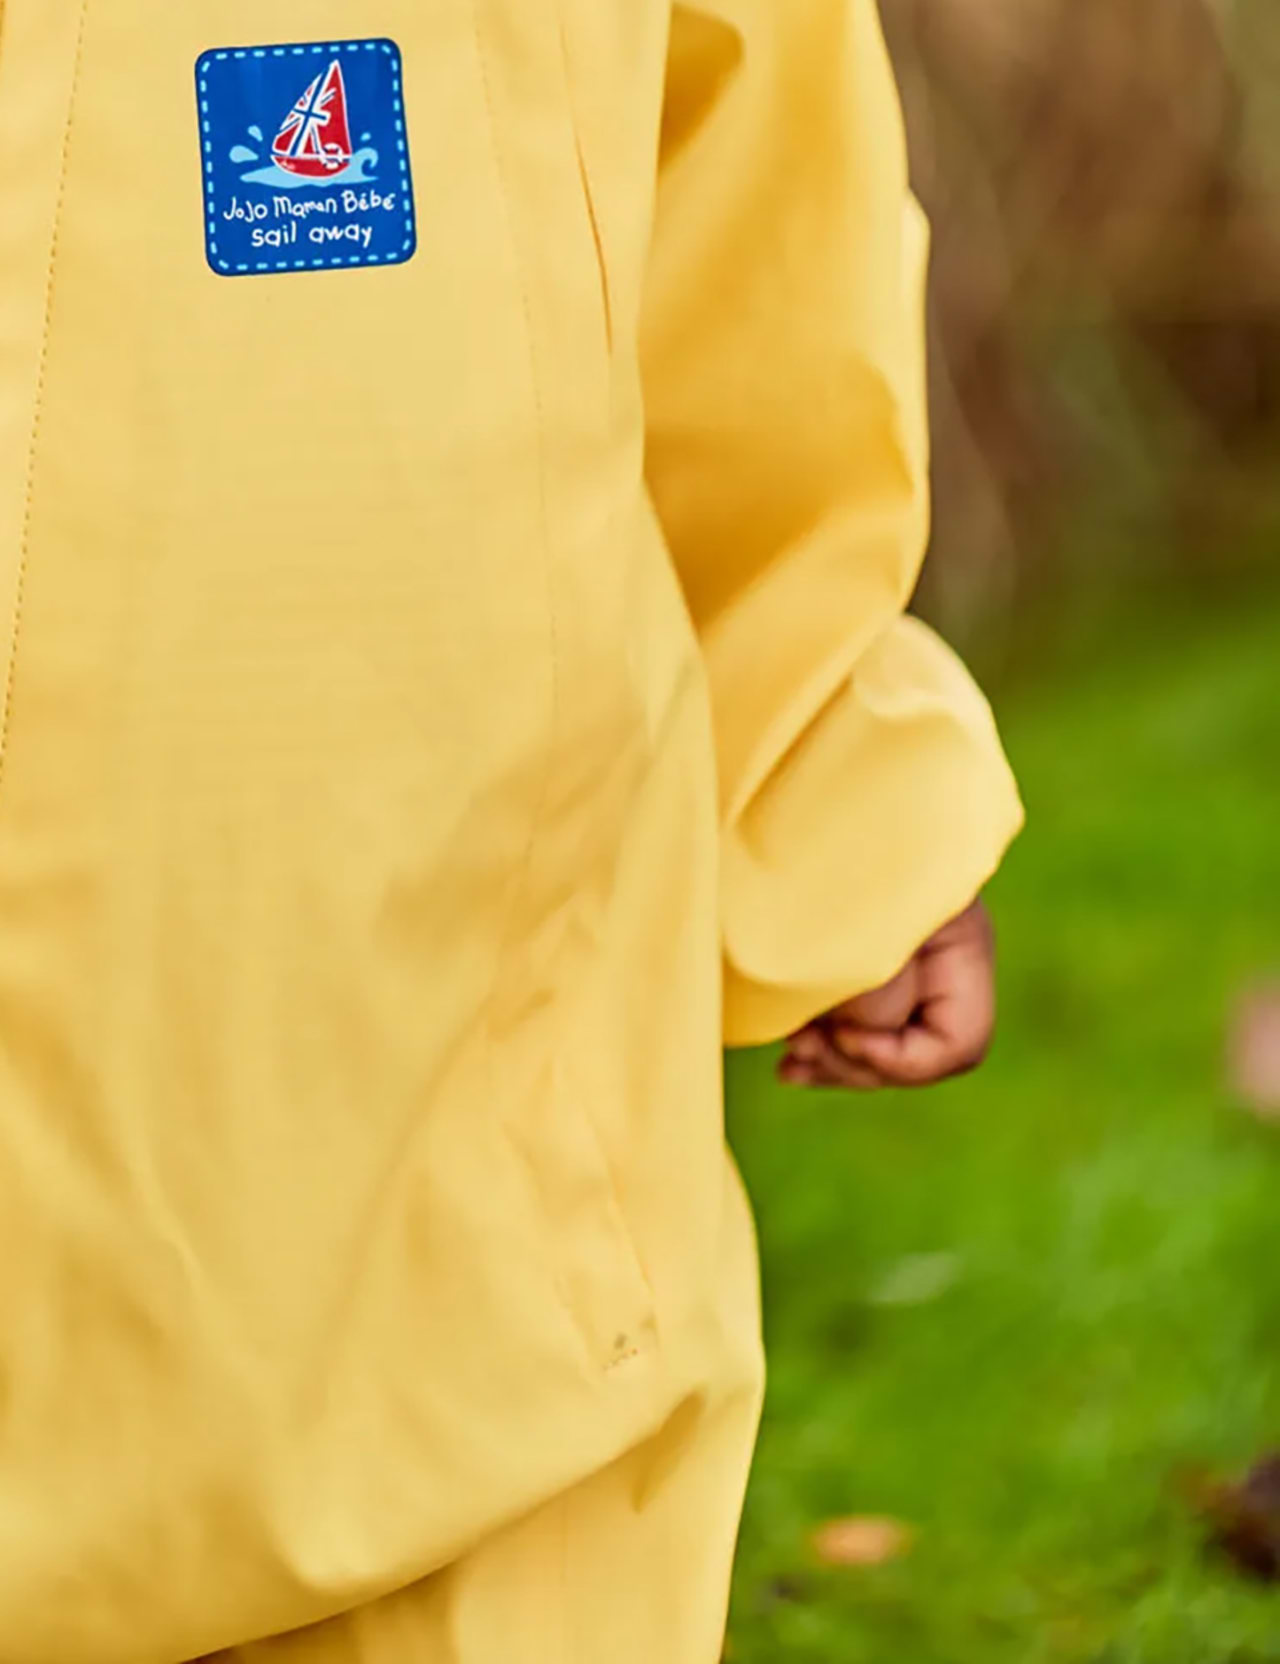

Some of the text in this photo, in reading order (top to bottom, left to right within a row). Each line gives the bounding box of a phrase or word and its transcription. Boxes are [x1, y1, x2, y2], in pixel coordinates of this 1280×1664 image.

[273, 196, 337, 219] Maman
[341, 189, 396, 213] Bébé
[251, 221, 372, 248] sail away
